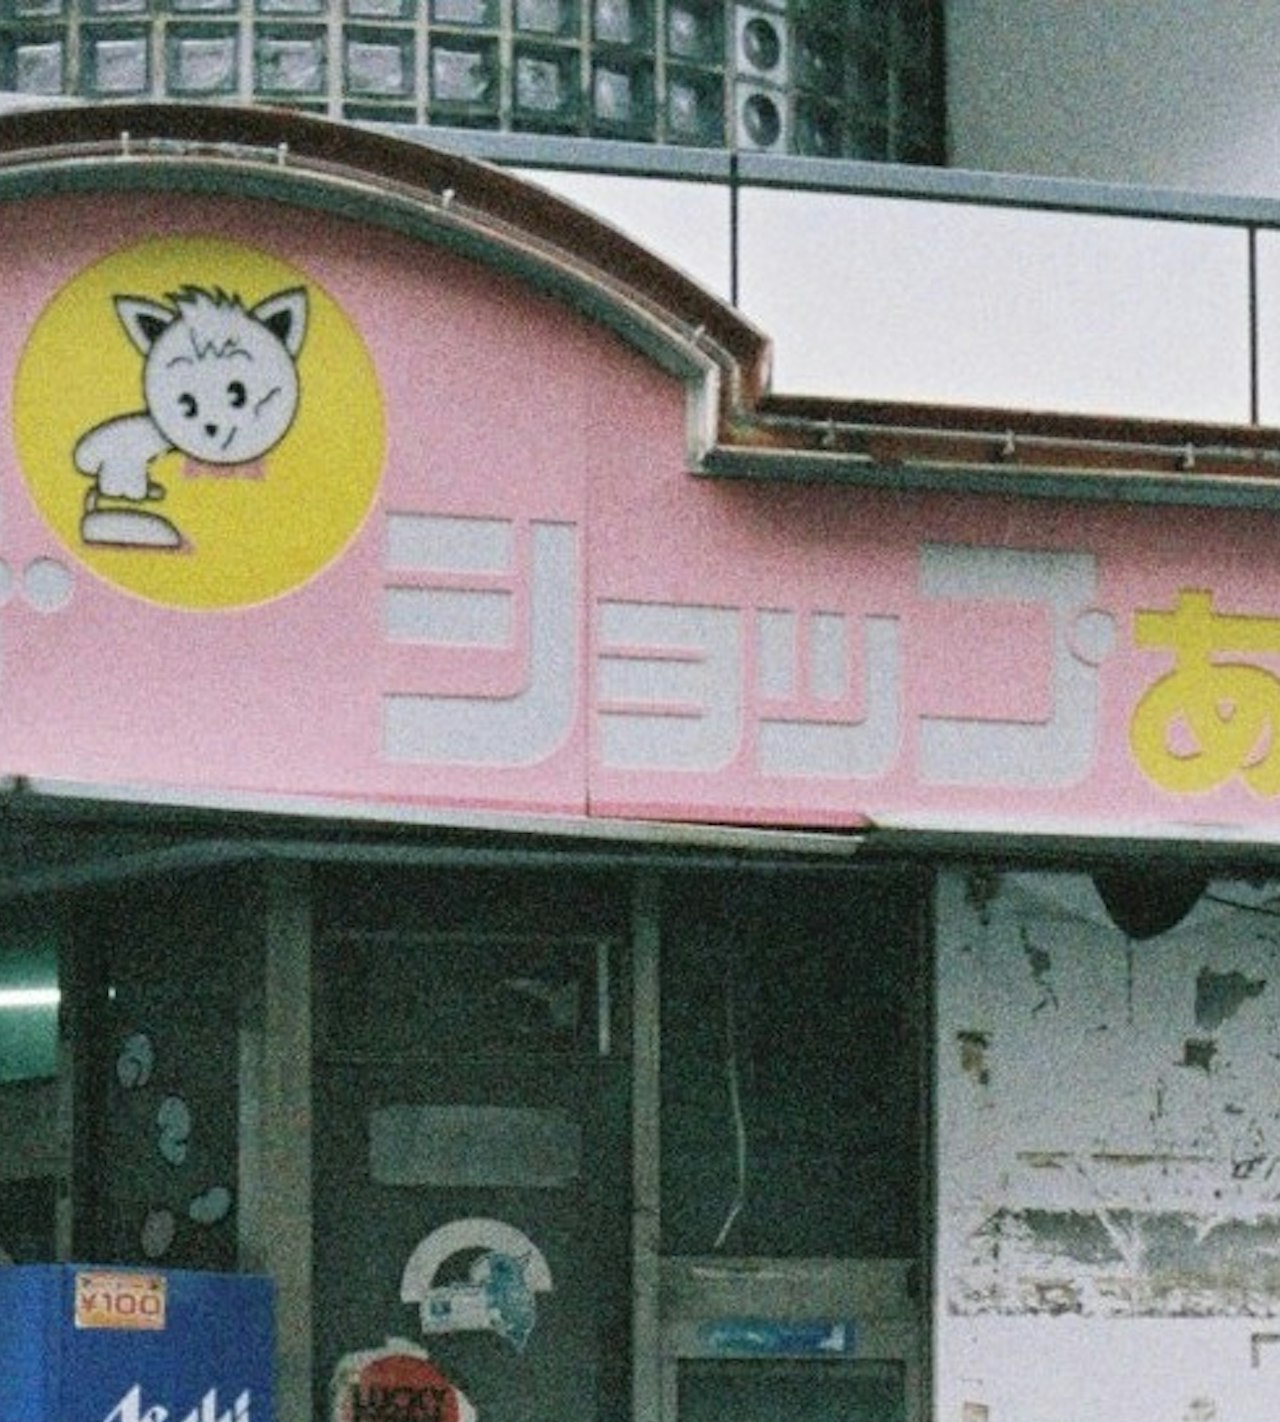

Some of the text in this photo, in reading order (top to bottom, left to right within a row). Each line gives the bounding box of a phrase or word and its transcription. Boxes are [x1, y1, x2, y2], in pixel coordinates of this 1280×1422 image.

[382, 512, 1116, 790] ショップ
[81, 1292, 160, 1315] ¥100
